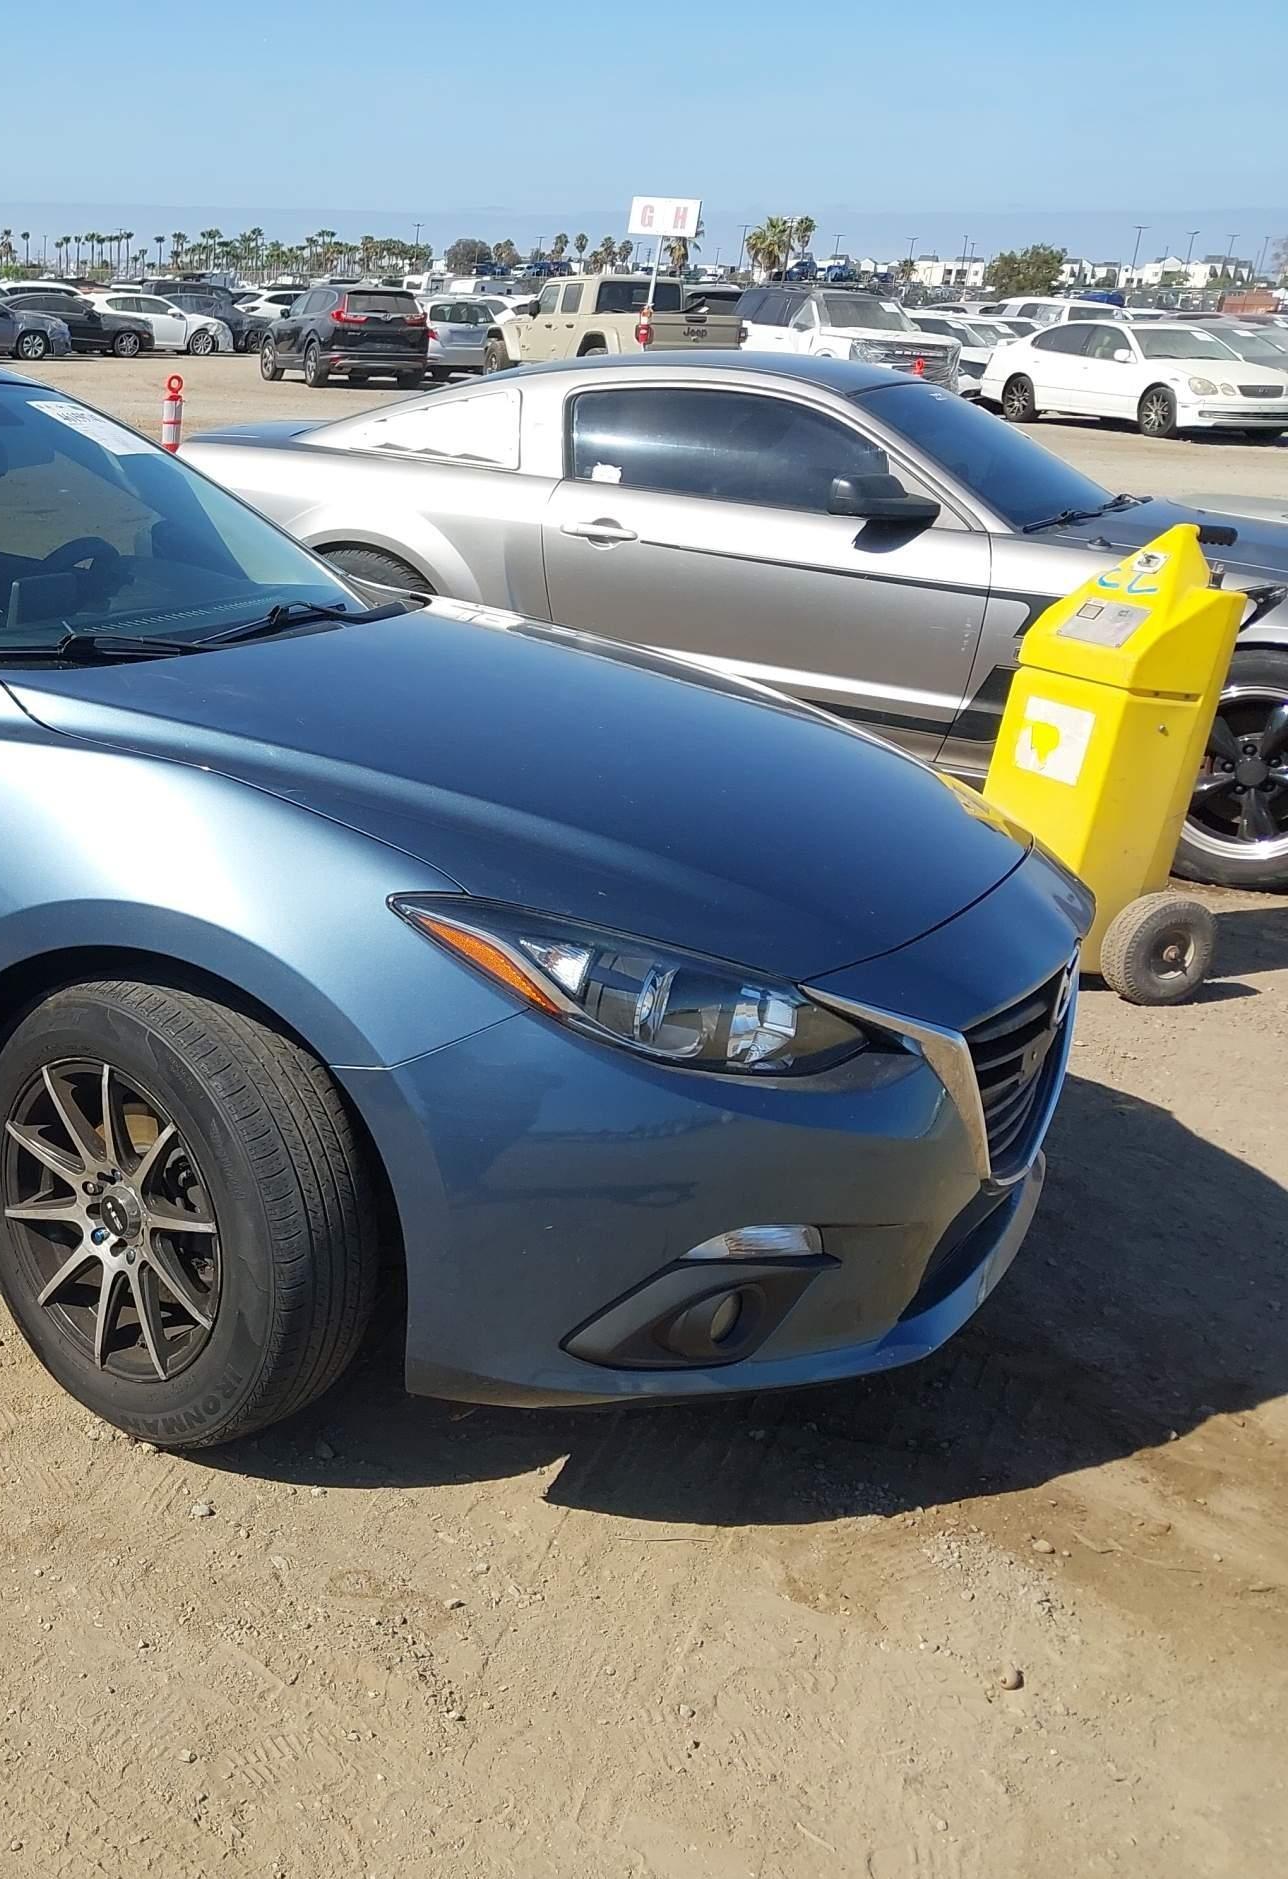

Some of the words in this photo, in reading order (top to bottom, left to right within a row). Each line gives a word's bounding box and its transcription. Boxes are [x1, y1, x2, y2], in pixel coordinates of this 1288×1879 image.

[640, 204, 655, 227] G
[673, 206, 688, 229] H
[683, 327, 707, 338] Jeep
[119, 1362, 243, 1435] IRONMAN
